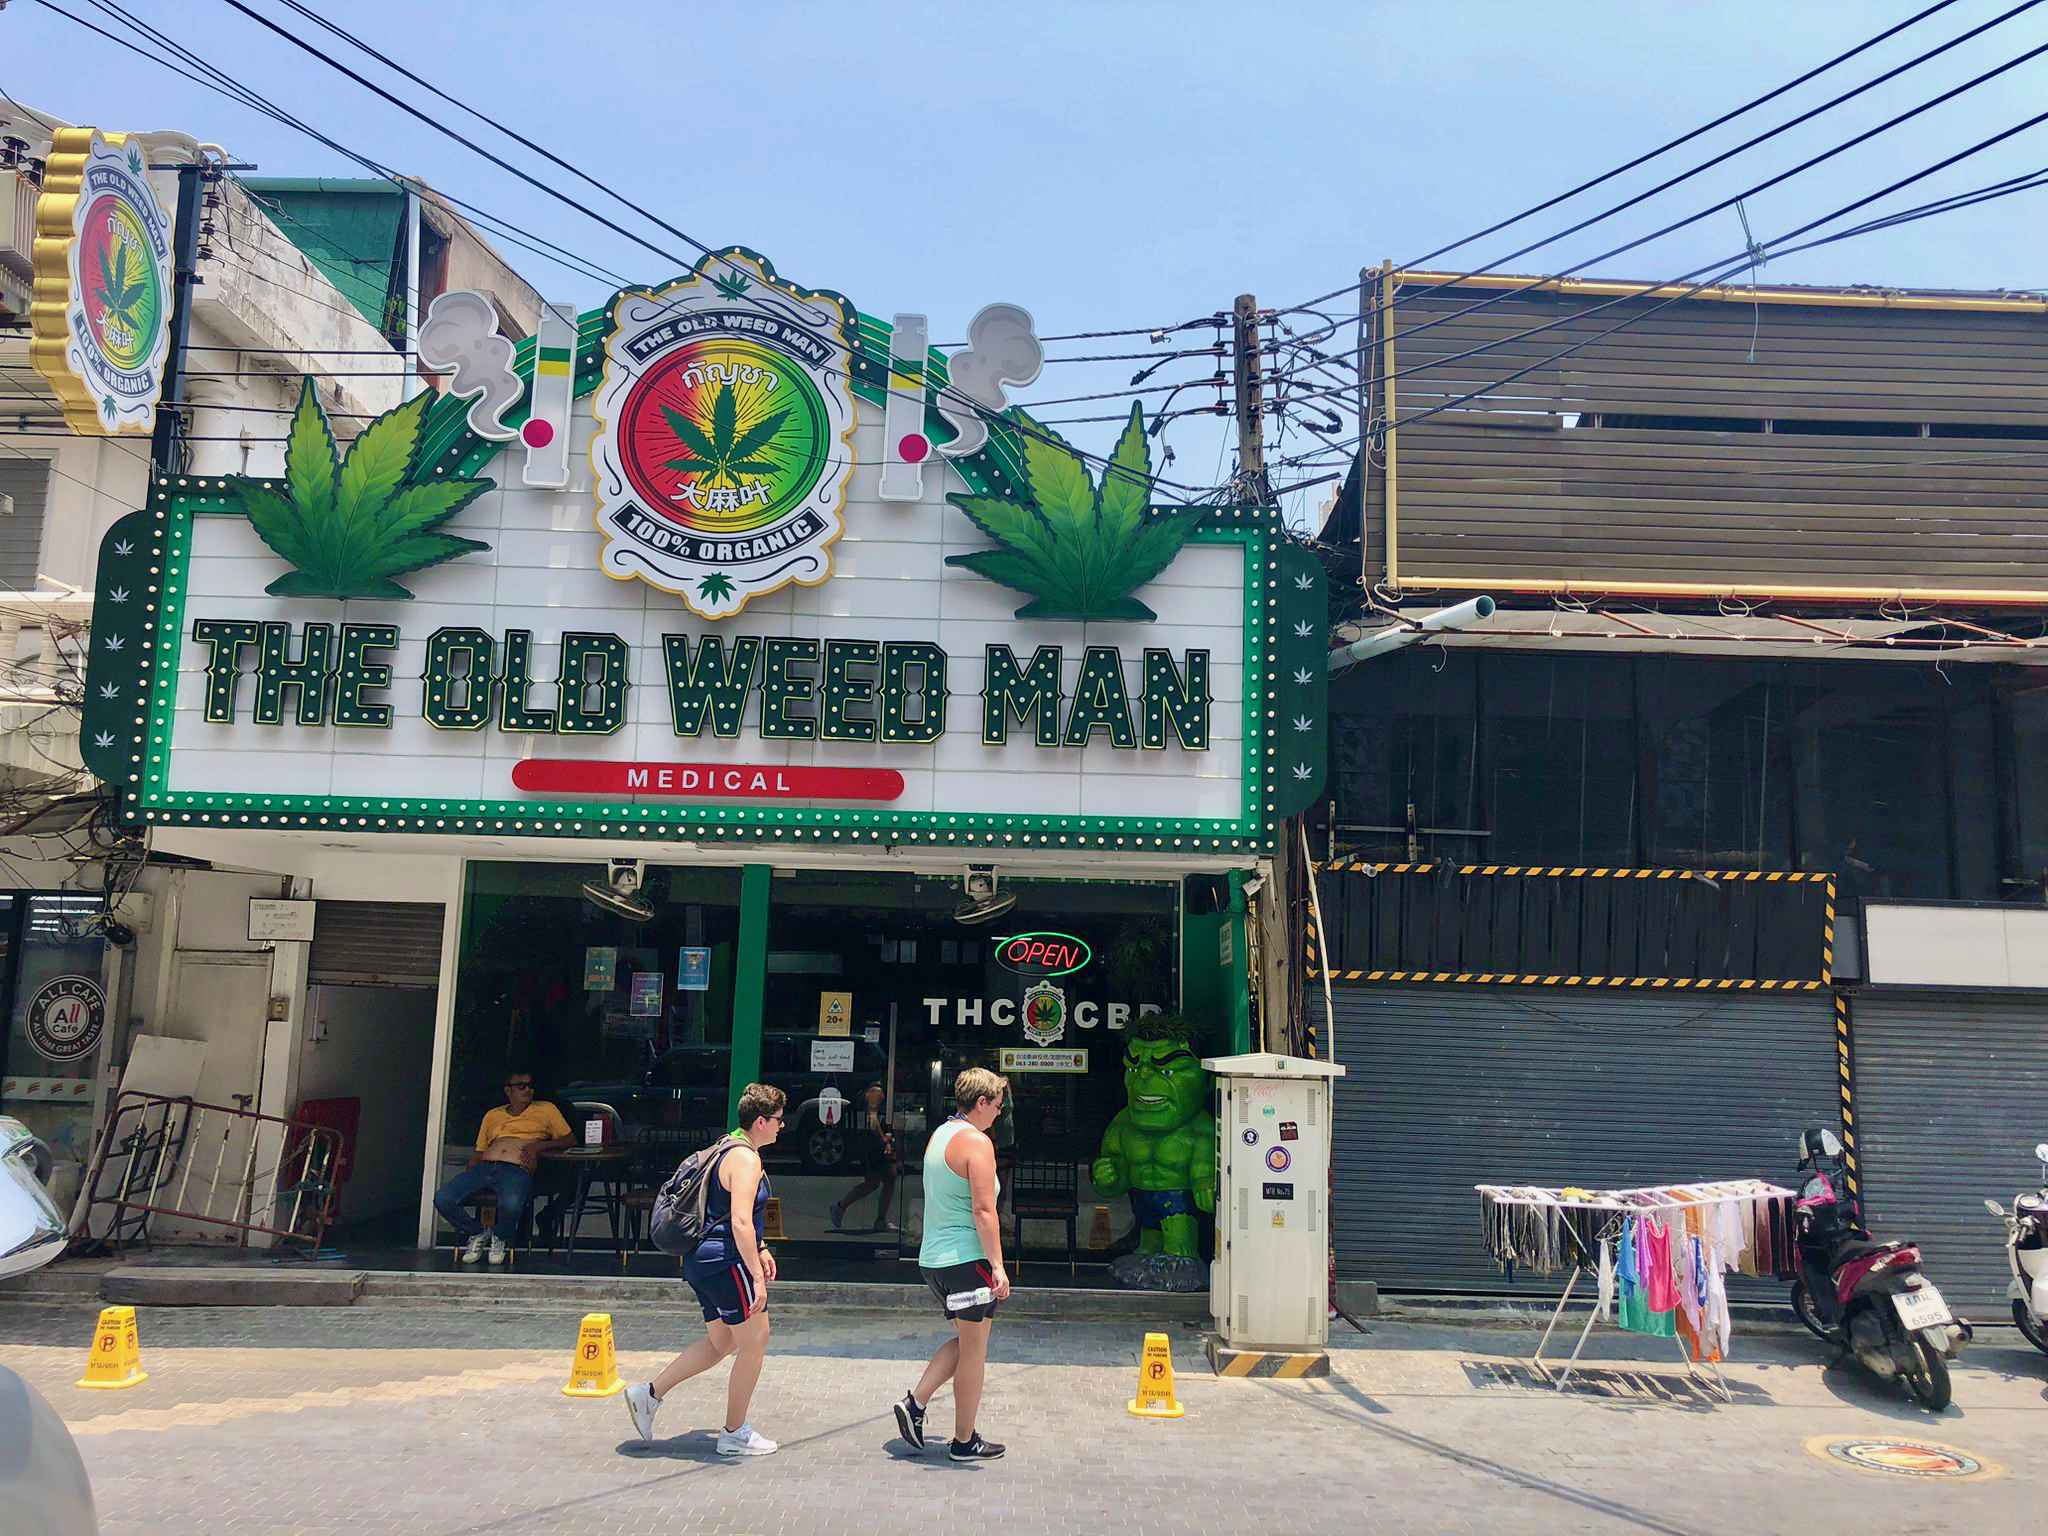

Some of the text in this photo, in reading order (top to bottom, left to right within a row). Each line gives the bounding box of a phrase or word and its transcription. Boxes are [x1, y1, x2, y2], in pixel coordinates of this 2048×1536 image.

[91, 171, 165, 257] THE OLD WEED MAN
[106, 210, 145, 263] กัญชา
[95, 310, 136, 354] 大麻叶
[633, 315, 826, 361] THE OLD WEED MAN
[78, 319, 151, 393] 100% ORGANIC
[681, 360, 779, 392] กัญชา
[670, 478, 772, 514] 大麻叶
[626, 511, 813, 562] 100% ORGANIC
[192, 618, 1215, 752] THE OLD WEED MAN
[627, 768, 791, 792] MEDICAL
[1007, 939, 1079, 969] OPEN
[39, 983, 100, 1011] ALL CAFE
[923, 997, 1016, 1027] THC
[52, 1024, 79, 1033] Cafe
[825, 1015, 844, 1024] 20+
[33, 1022, 100, 1053] ALL TIME GREAT TASTE
[1265, 1187, 1276, 1195] MTB
[1912, 1311, 1943, 1326] 6595
